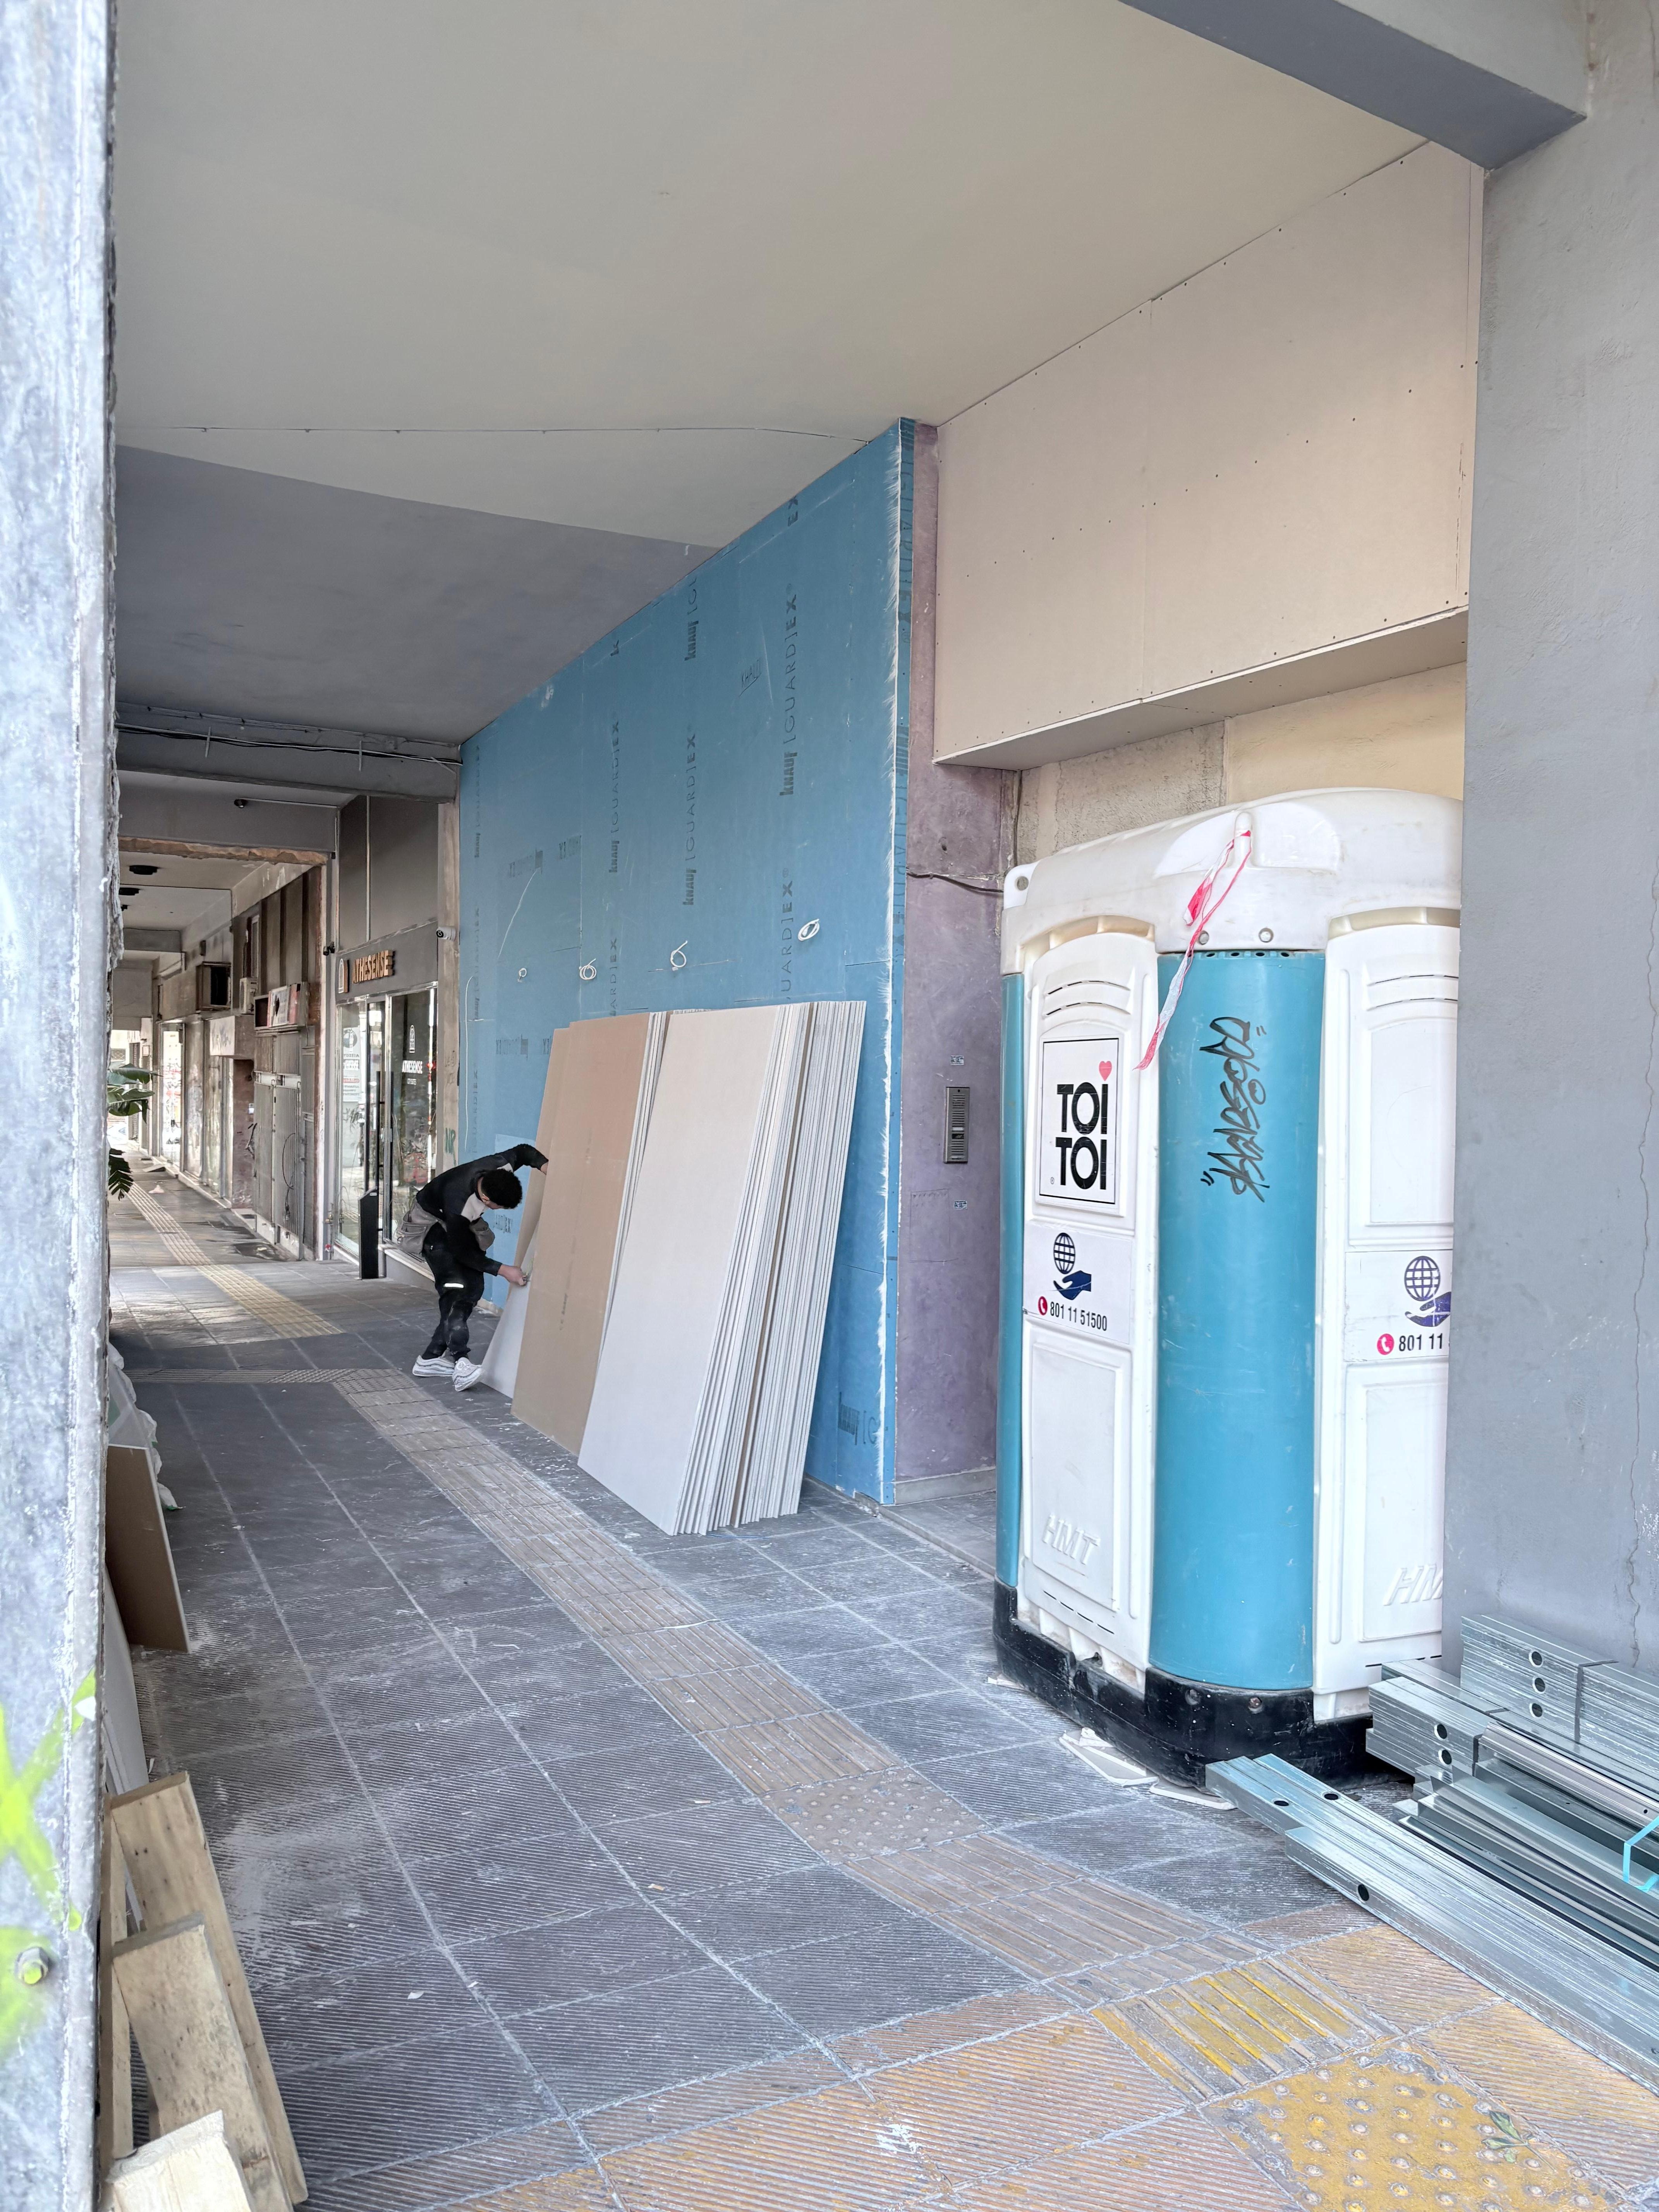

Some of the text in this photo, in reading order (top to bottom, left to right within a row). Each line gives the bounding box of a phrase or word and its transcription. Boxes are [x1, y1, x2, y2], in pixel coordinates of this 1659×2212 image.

[780, 751, 798, 796] KNAUF
[682, 868, 697, 905] KNAUF
[781, 880, 793, 1000] UARD]EX
[352, 950, 393, 984] ATHESENSE
[402, 1060, 423, 1074] ATHESENSE
[1057, 1082, 1108, 1135] TOI
[1056, 1137, 1107, 1190] TOI
[1050, 1302, 1107, 1331] 801 11 51500
[1399, 1333, 1443, 1352] 801 11
